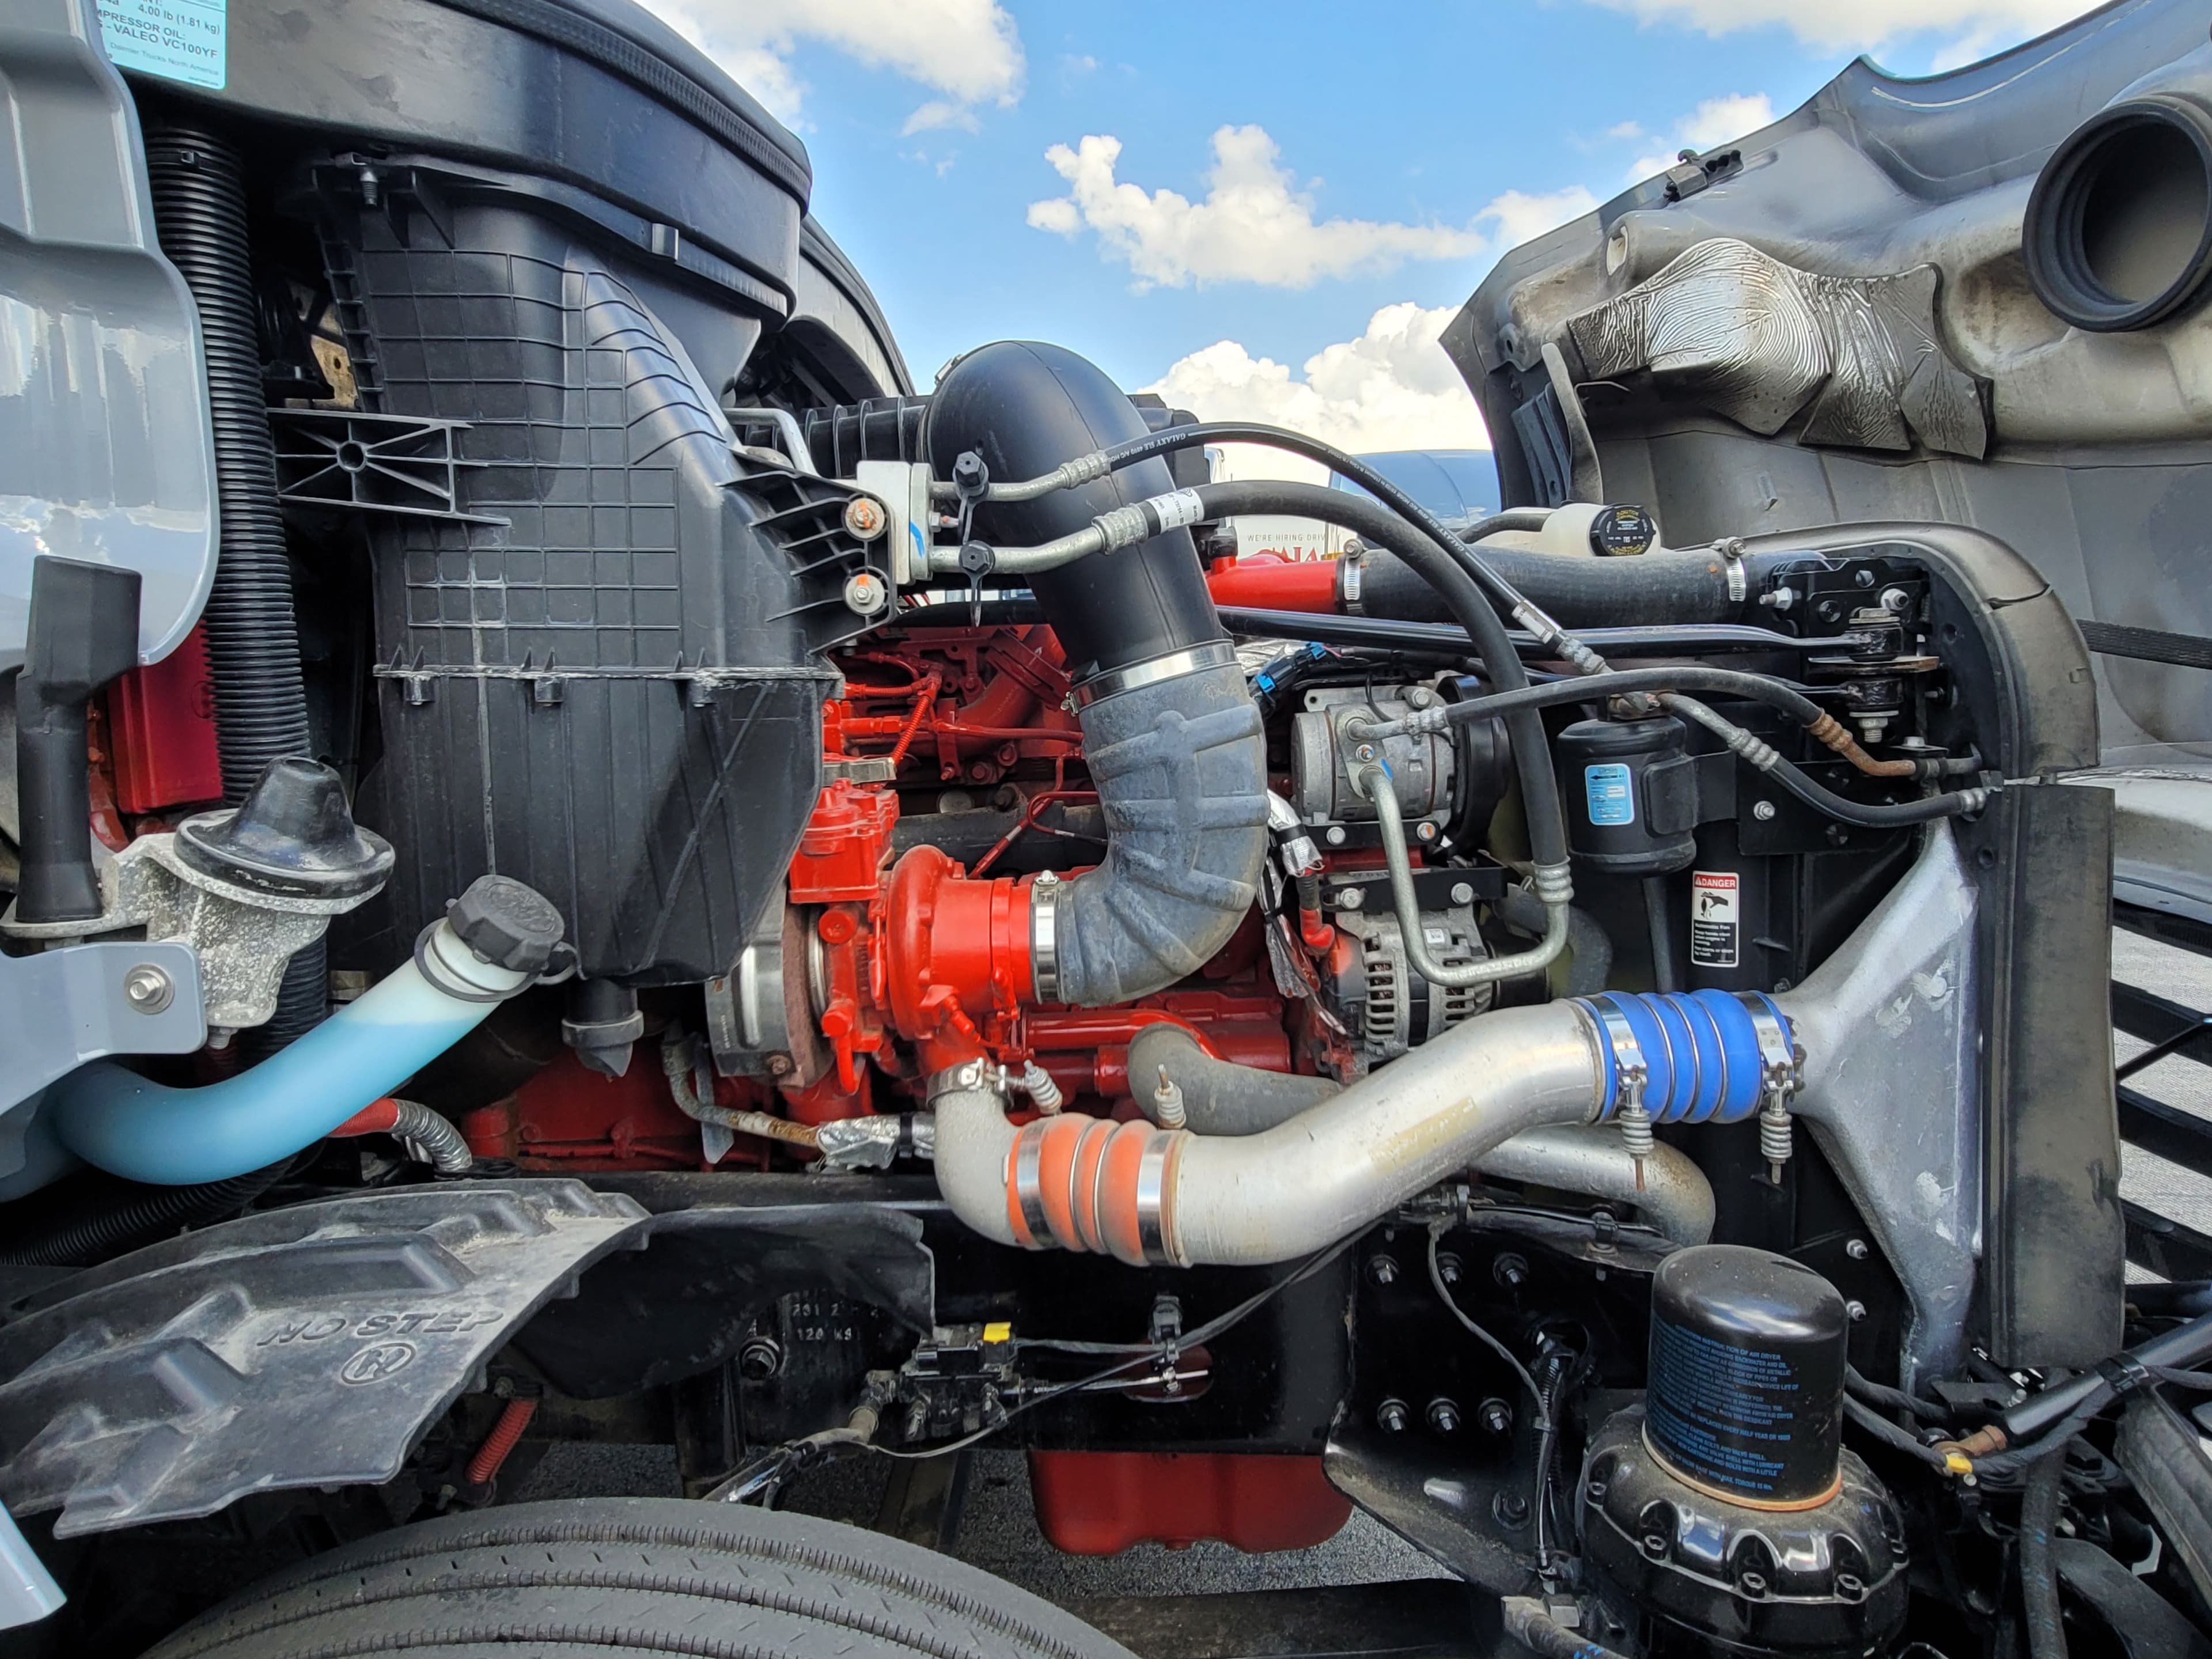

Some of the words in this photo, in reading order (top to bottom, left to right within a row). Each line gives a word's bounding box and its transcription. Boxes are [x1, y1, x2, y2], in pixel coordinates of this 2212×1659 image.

[97, 9, 160, 33] MPRESSOR
[164, 27, 186, 40] OIL:
[138, 5, 160, 17] 4.00
[164, 10, 173, 21] lb
[177, 14, 200, 28] (1.81
[204, 22, 220, 35] kg)
[113, 24, 158, 43] VALEO
[162, 36, 217, 58] VC100YF
[110, 42, 139, 54] Daimler
[141, 50, 166, 62] Trucks
[168, 57, 188, 68] North
[190, 63, 219, 75] America
[1156, 433, 1186, 447] GALAXY
[1306, 533, 1325, 541] DRIV
[1440, 528, 1464, 551] GALAXY
[1701, 879, 1736, 888] DANGER
[256, 1317, 347, 1347] NO
[356, 1311, 504, 1336] STEP
[1761, 1350, 1781, 1360] DRYER
